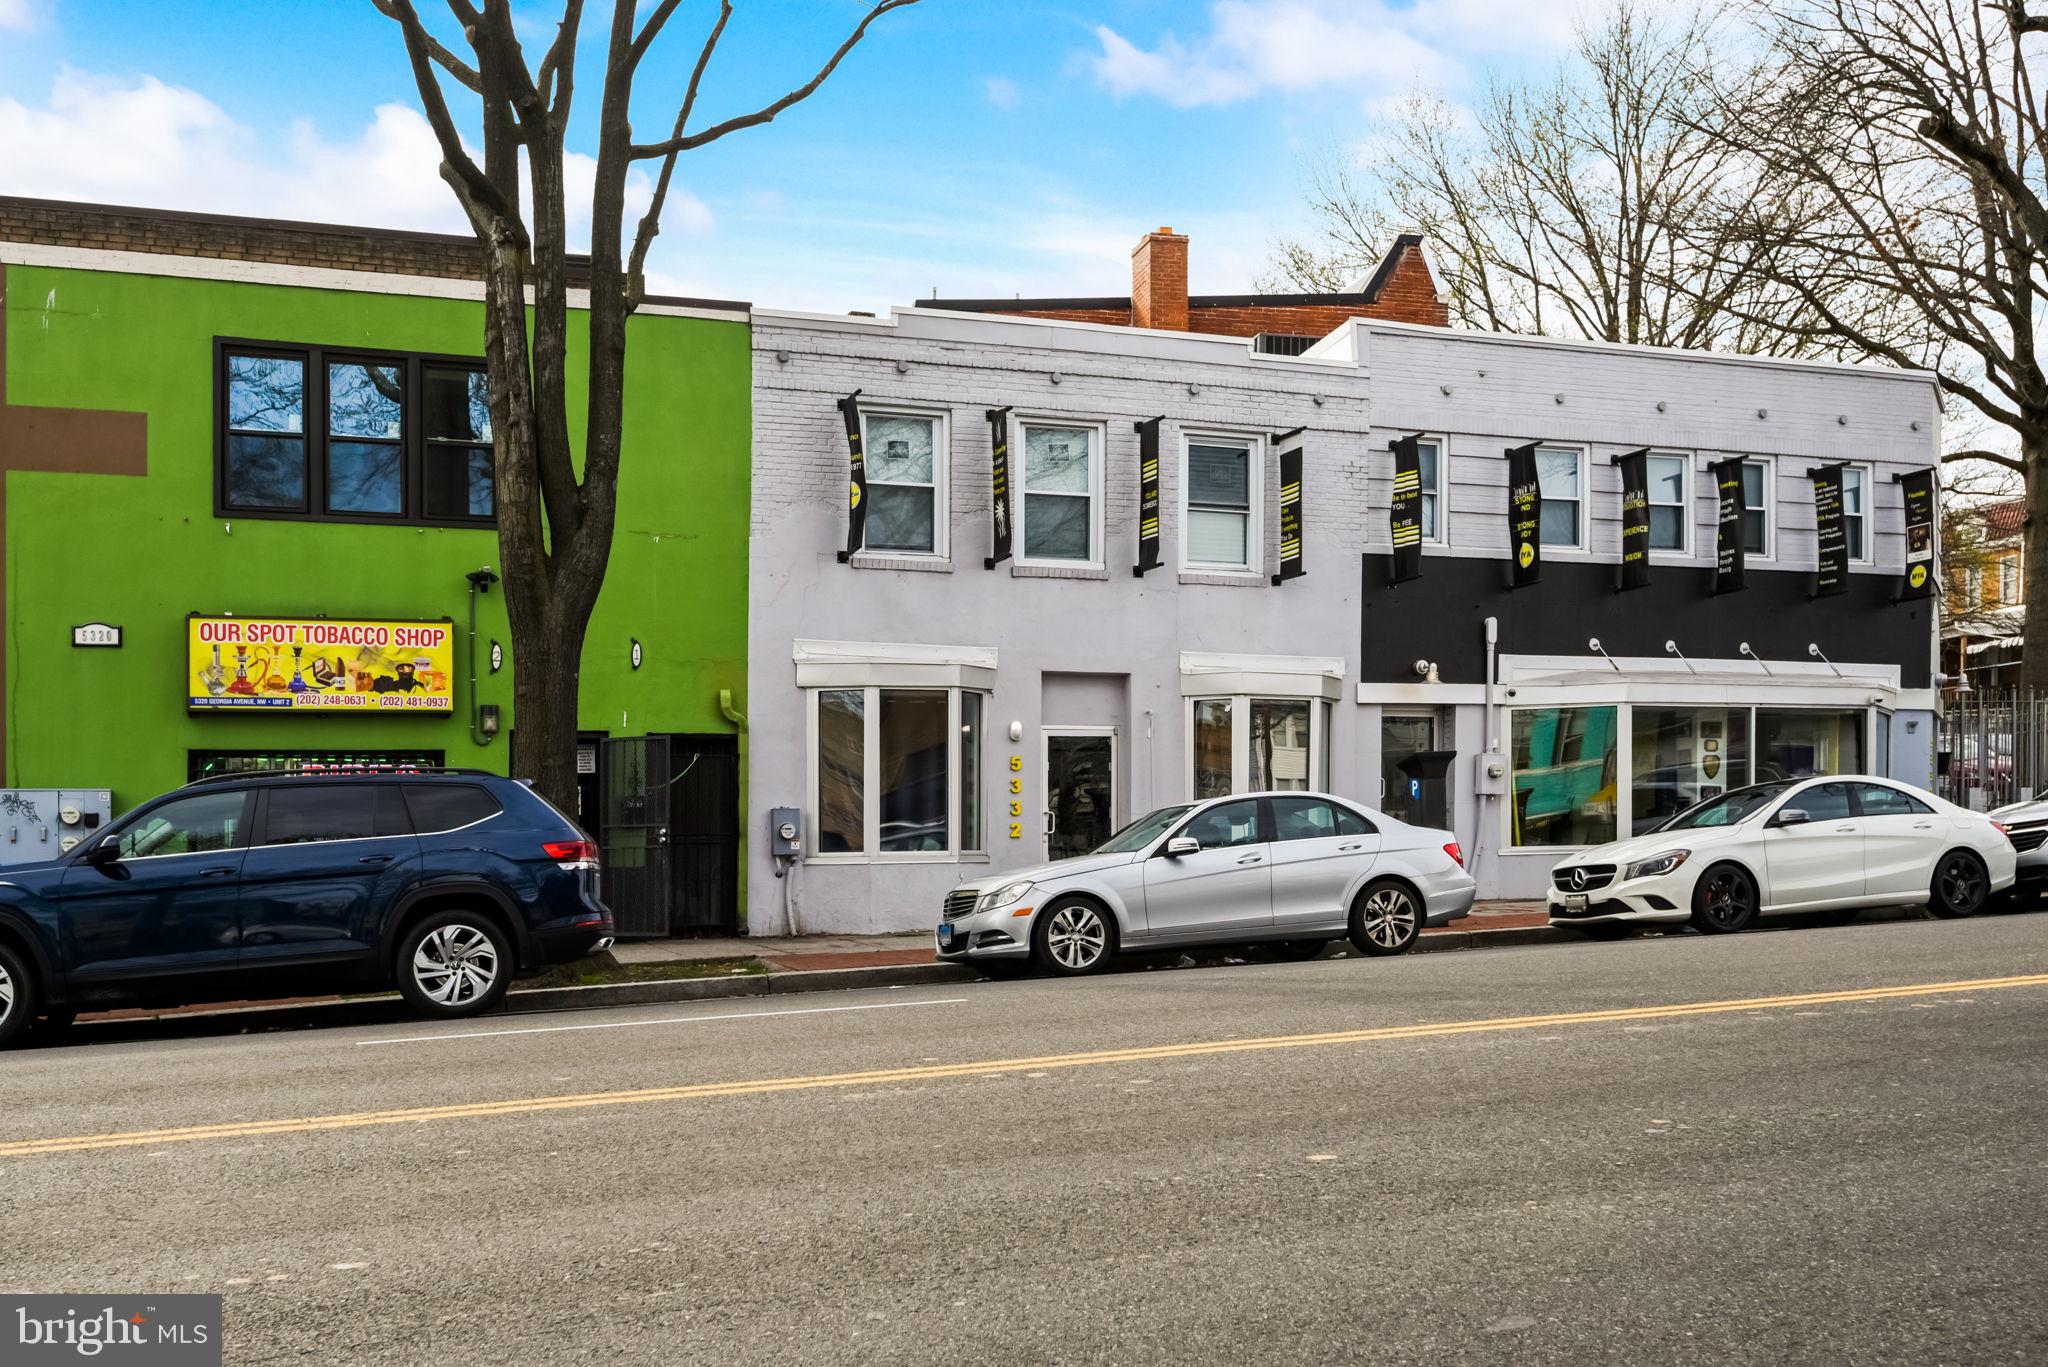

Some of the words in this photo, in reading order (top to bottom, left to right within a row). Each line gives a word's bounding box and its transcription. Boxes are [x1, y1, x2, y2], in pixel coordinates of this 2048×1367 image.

[81, 630, 112, 642] 5320
[200, 622, 241, 642] OUR
[247, 623, 297, 643] SPOT
[302, 624, 389, 646] TOBACCO
[395, 627, 445, 647] SHOP
[492, 649, 500, 662] 2
[296, 694, 320, 706] (202)
[323, 695, 366, 705] 248-0631
[380, 696, 403, 707] (202)
[406, 697, 449, 707] 481-0937
[1411, 780, 1418, 796] P
[1010, 755, 1022, 839] 5332
